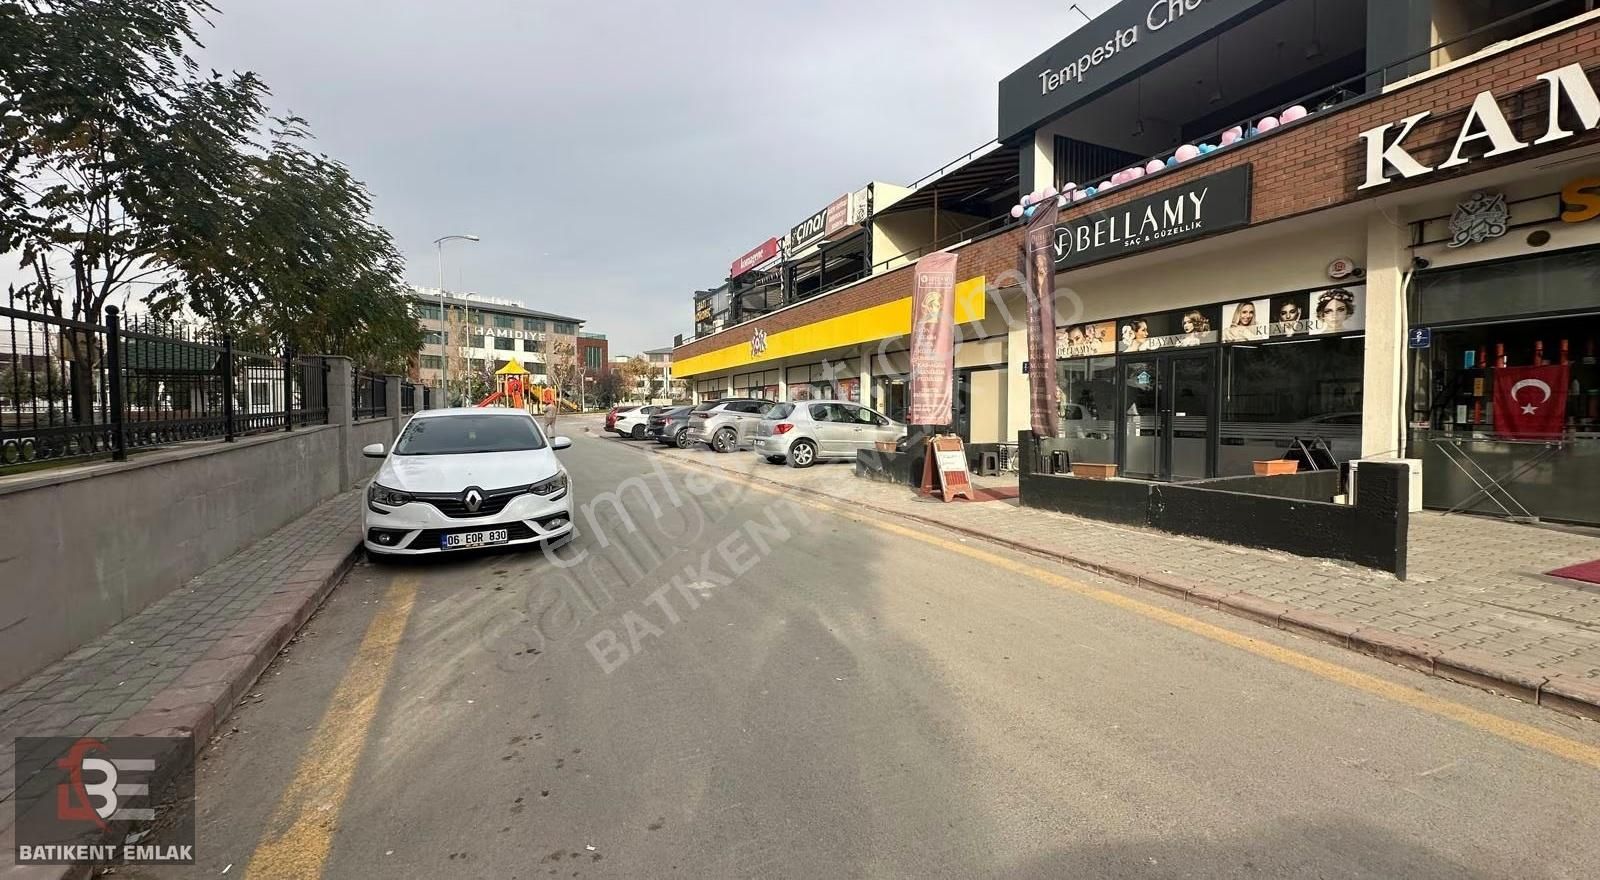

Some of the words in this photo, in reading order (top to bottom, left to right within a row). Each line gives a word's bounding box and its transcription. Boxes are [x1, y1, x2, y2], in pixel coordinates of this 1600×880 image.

[1038, 25, 1139, 95] Tempesta
[1076, 187, 1208, 252] BELLAMY
[1124, 238, 1141, 247] SAÇ
[1154, 220, 1202, 239] GÜZELLİK
[447, 535, 460, 546] 06
[465, 532, 484, 544] EOR
[489, 530, 507, 541] 830
